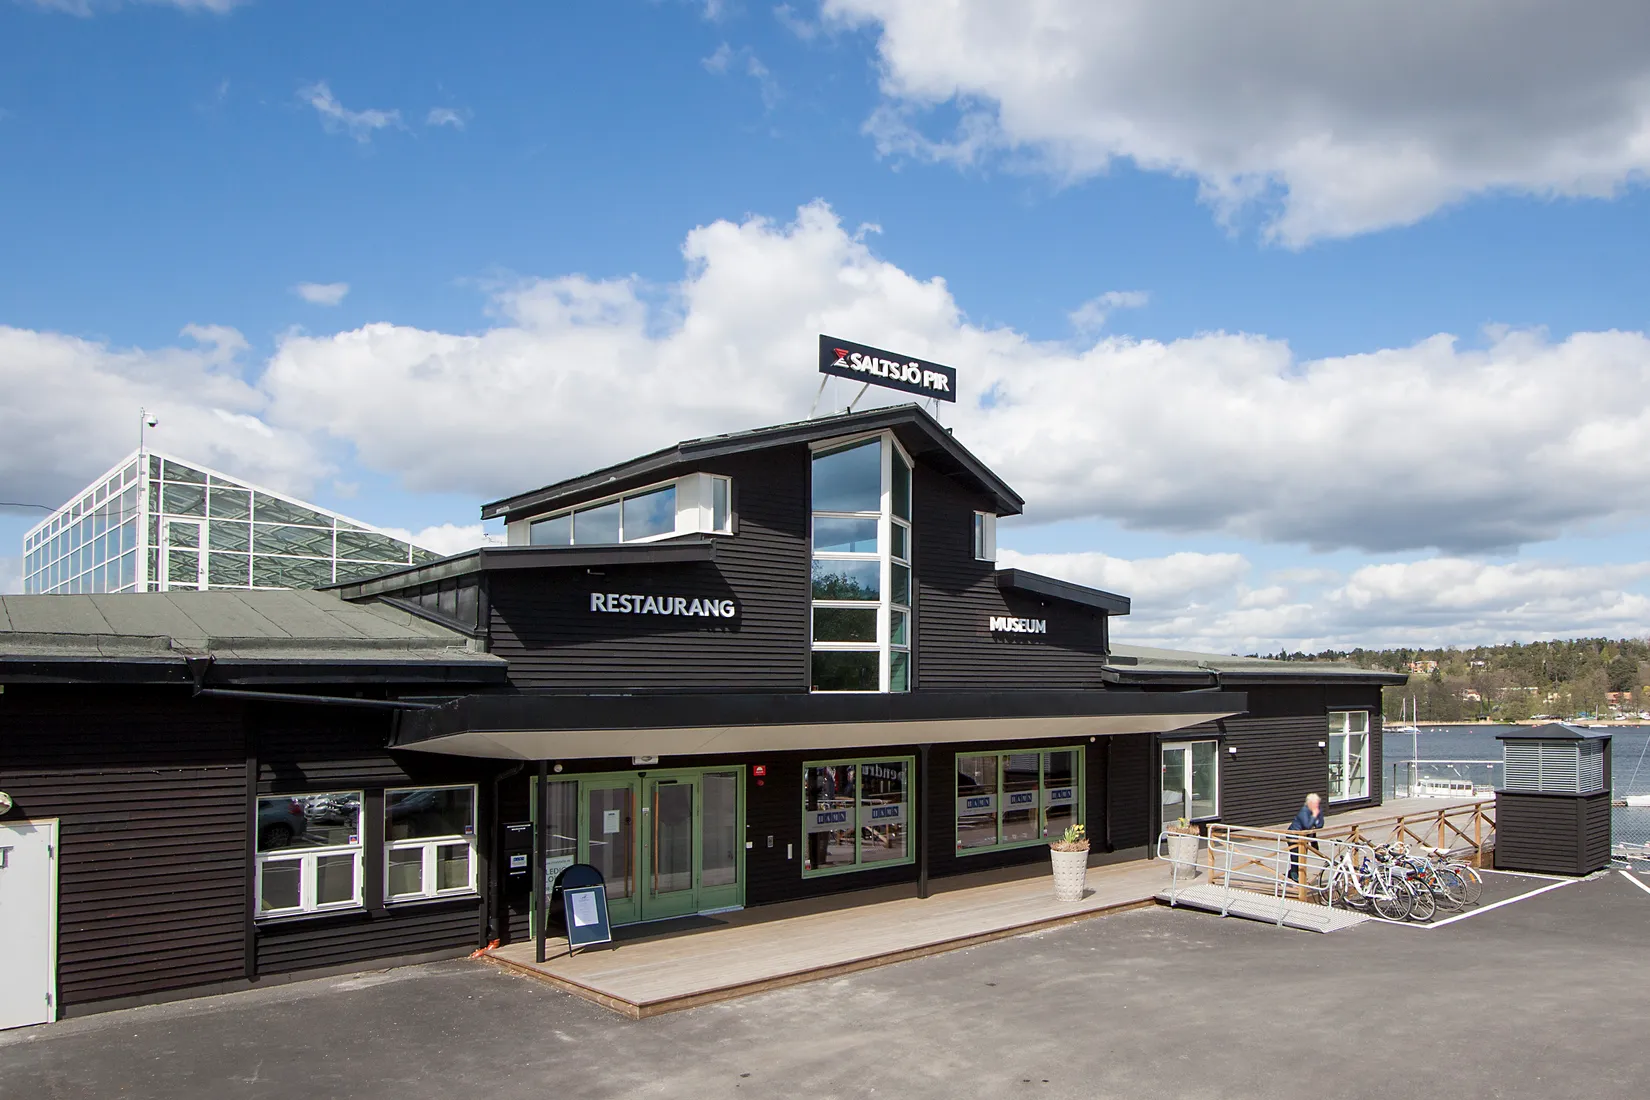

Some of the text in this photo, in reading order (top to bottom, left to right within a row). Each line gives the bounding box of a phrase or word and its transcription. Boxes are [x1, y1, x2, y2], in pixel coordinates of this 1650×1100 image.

[850, 353, 950, 392] SALTSJÖ PIR
[590, 592, 735, 618] RESTAURANG
[989, 616, 1047, 634] MUSEUM
[967, 797, 989, 808] HAMN
[818, 812, 845, 823] HAMN
